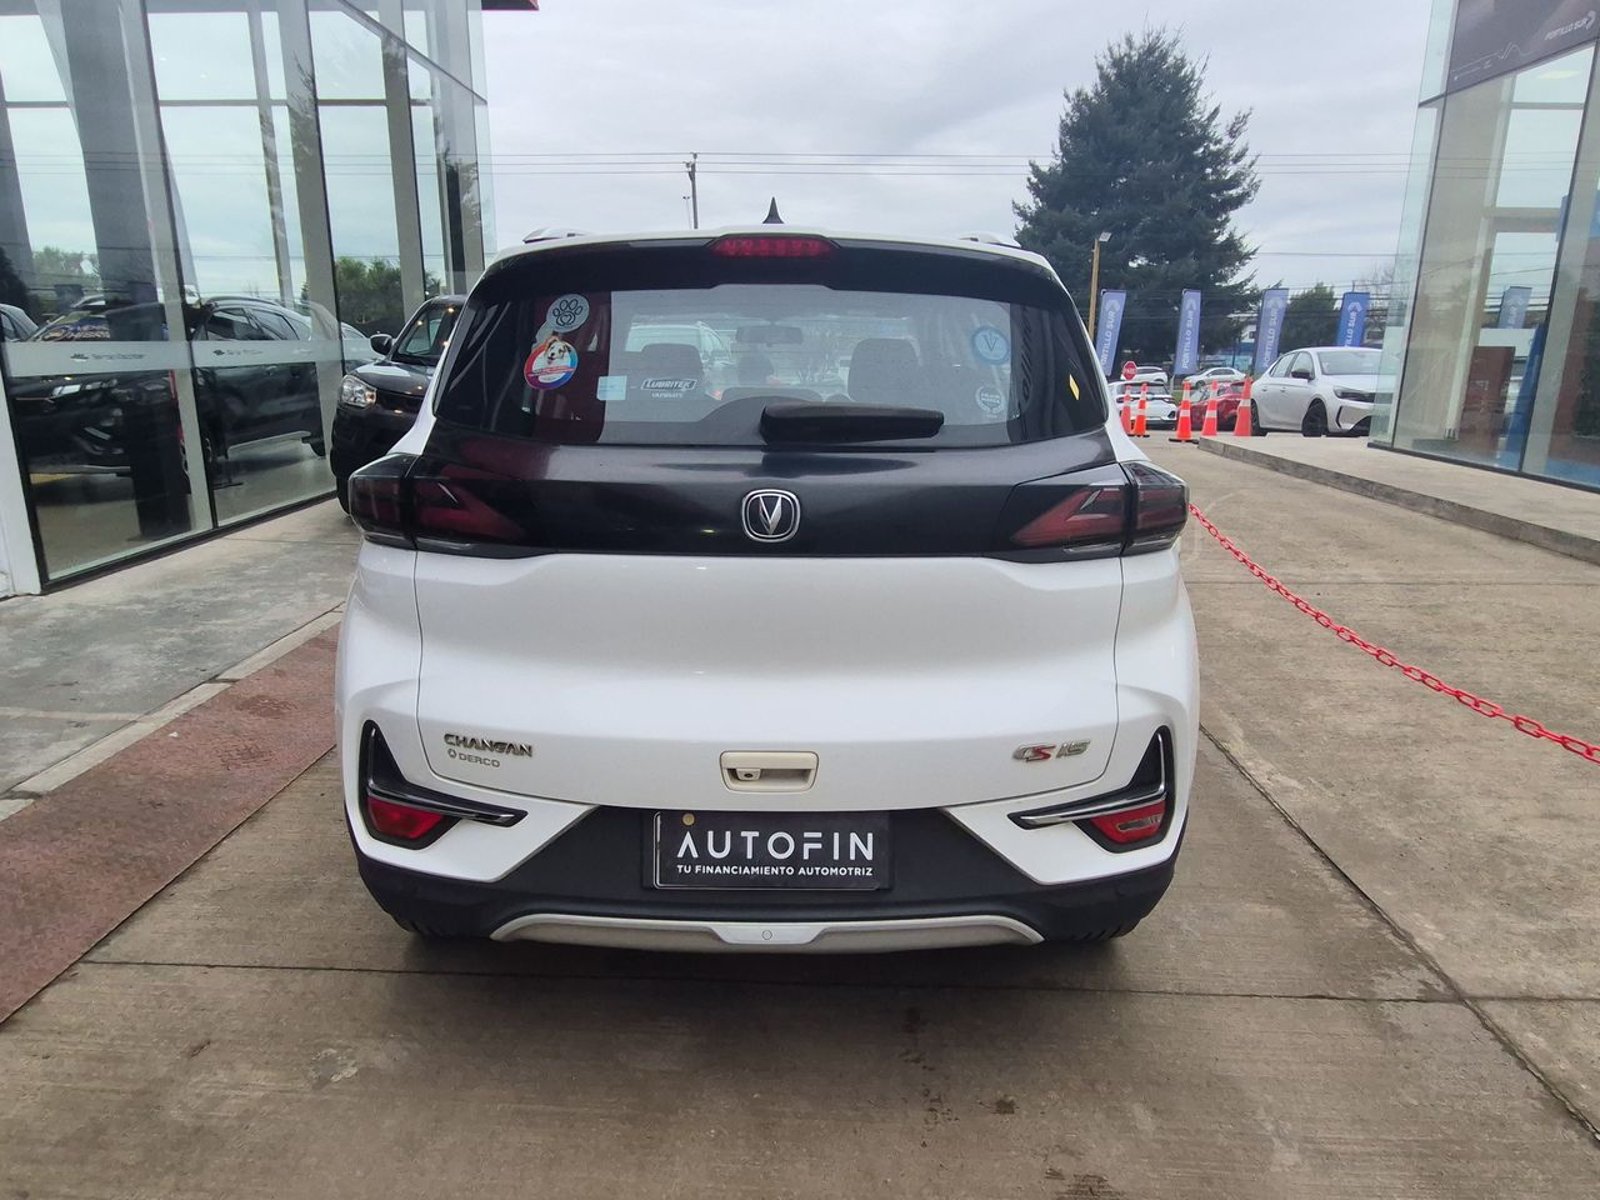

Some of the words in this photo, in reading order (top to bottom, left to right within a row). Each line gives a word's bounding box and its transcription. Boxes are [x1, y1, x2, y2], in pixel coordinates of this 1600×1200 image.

[1186, 311, 1194, 328] SUR
[1269, 310, 1278, 326] SUR
[1348, 311, 1357, 327] SUR
[1100, 330, 1112, 366] ORTILLO
[1106, 311, 1116, 329] SUR
[1182, 329, 1192, 369] PORTILLO
[444, 733, 533, 757] CHANGAN
[459, 753, 501, 767] DERCO
[677, 830, 873, 861] AUTOFIN
[677, 864, 692, 874] TU
[695, 865, 795, 876] FINANCIAMIENTO
[798, 867, 873, 877] AUTOMOTRIZ
